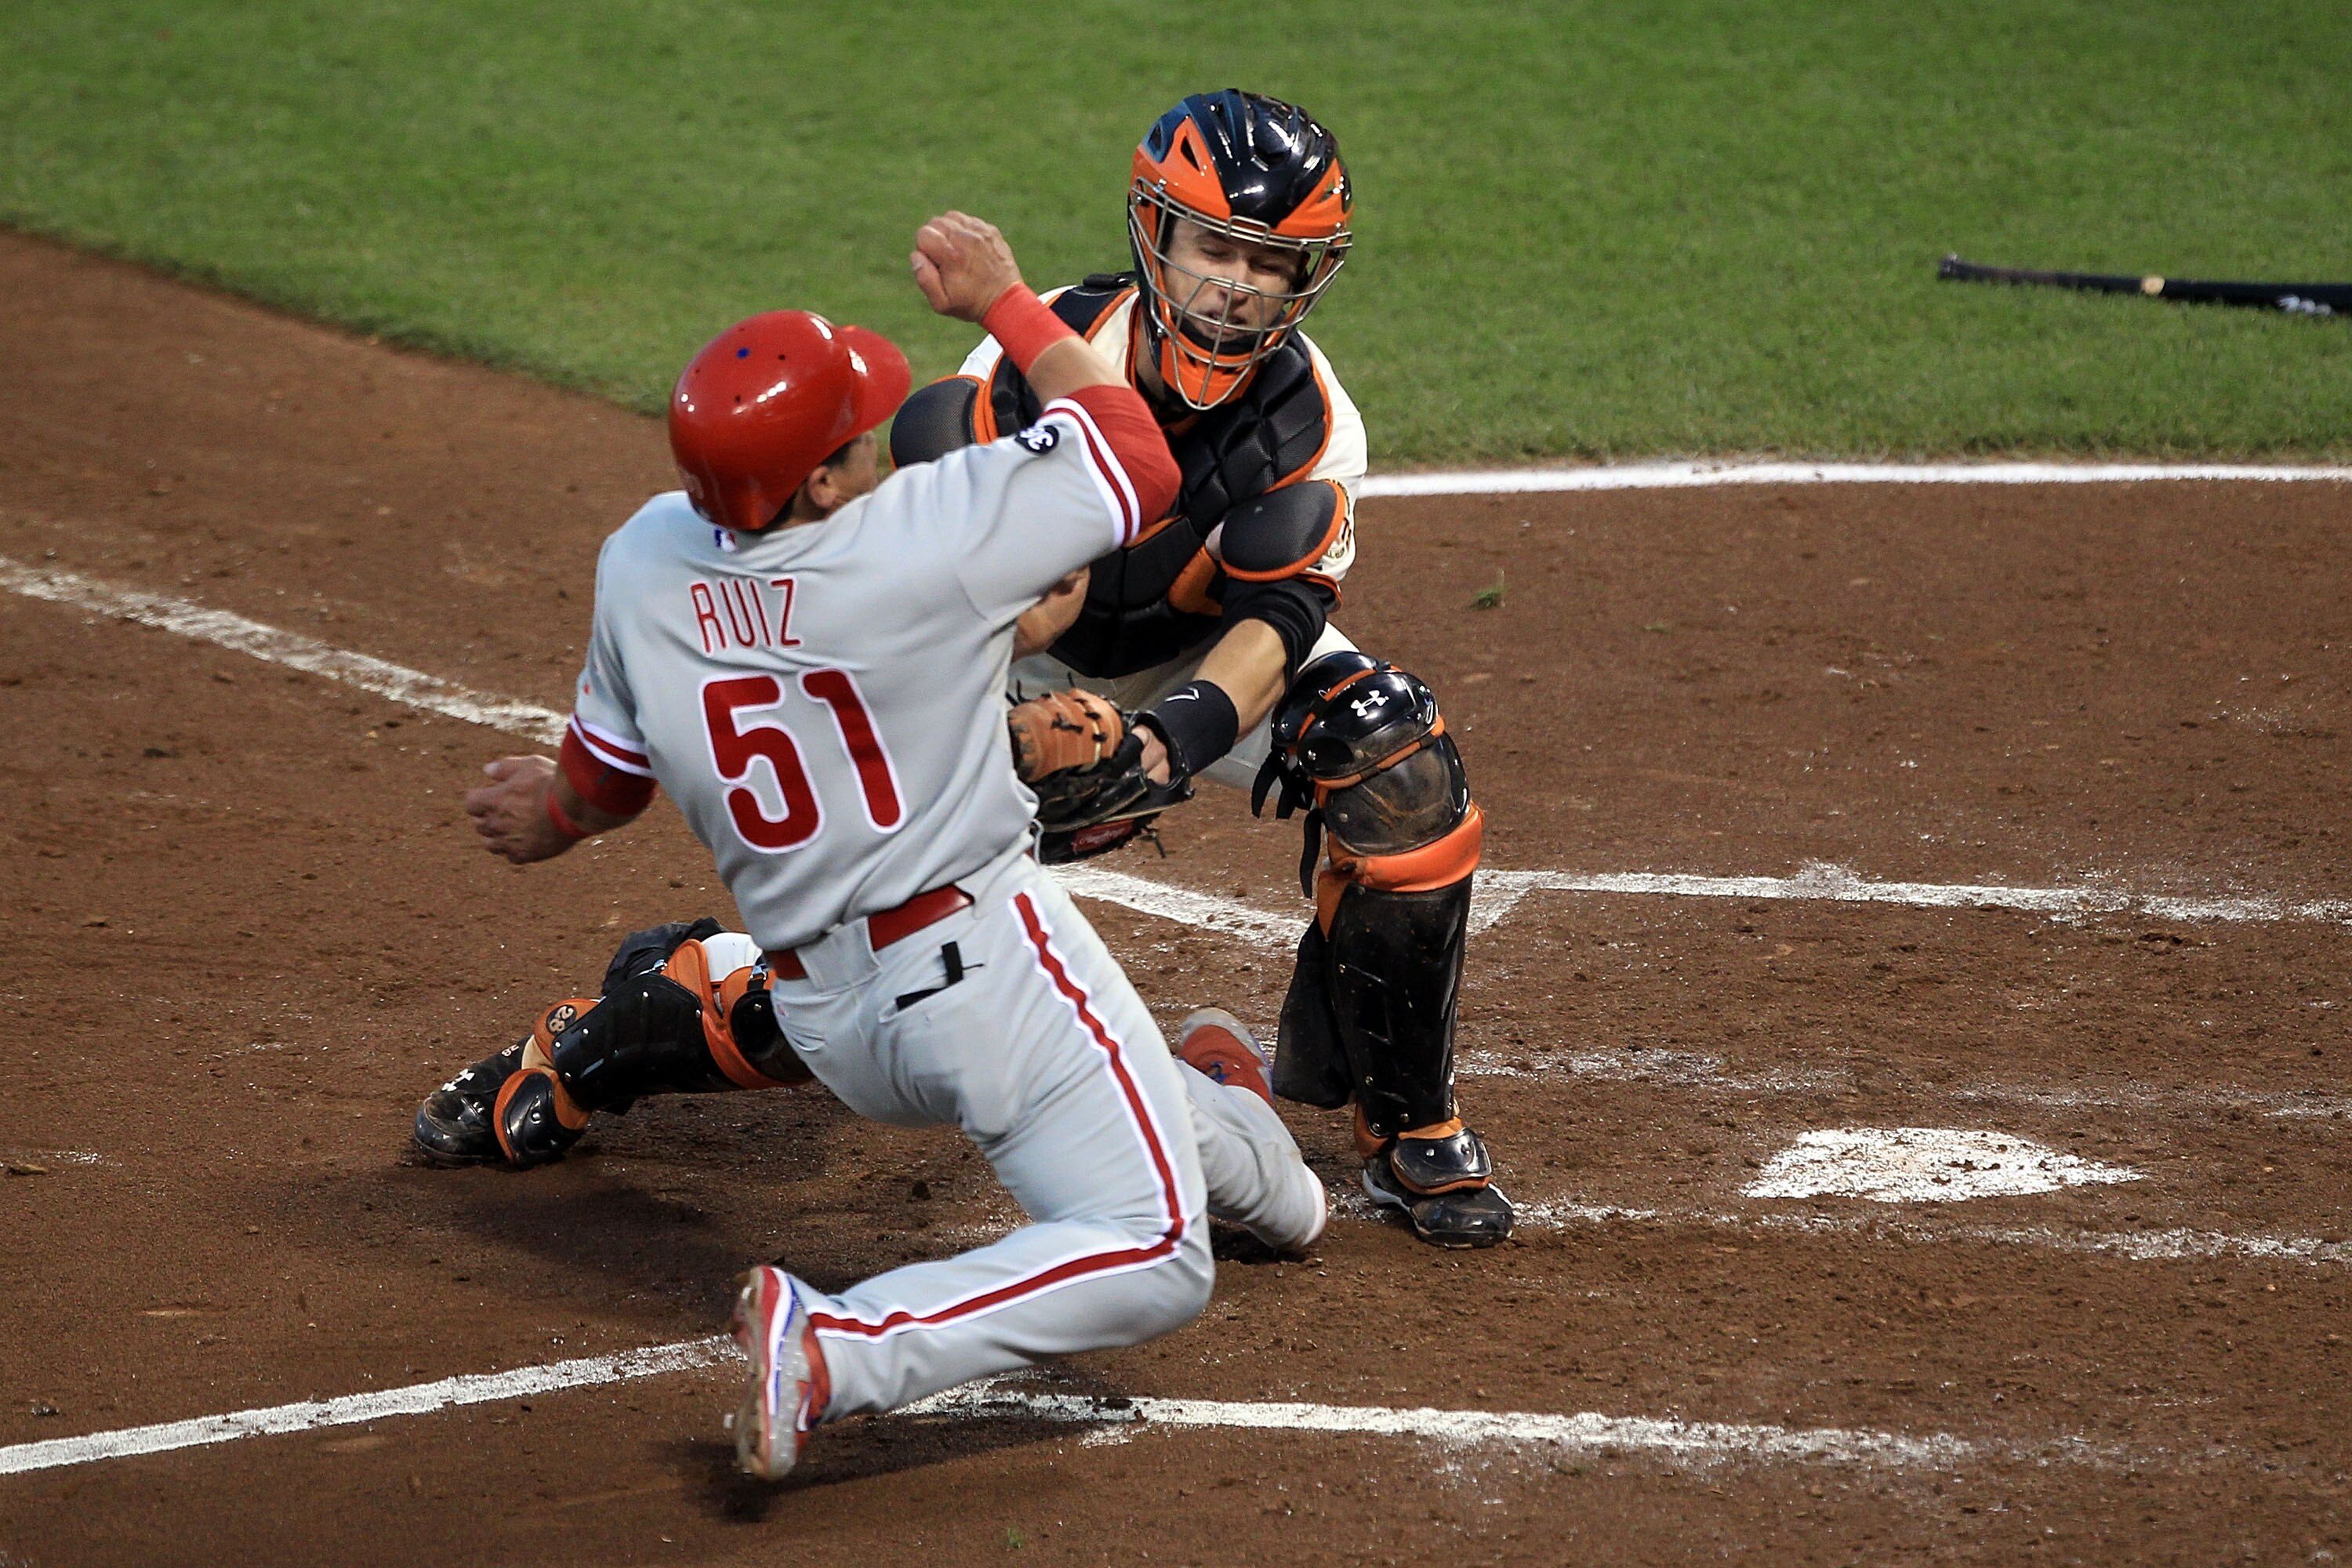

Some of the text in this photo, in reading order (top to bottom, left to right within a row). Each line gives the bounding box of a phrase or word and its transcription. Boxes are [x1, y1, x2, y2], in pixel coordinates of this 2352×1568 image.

[690, 577, 802, 655] RUIZ
[702, 667, 905, 853] 51
[549, 1005, 574, 1033] 28
